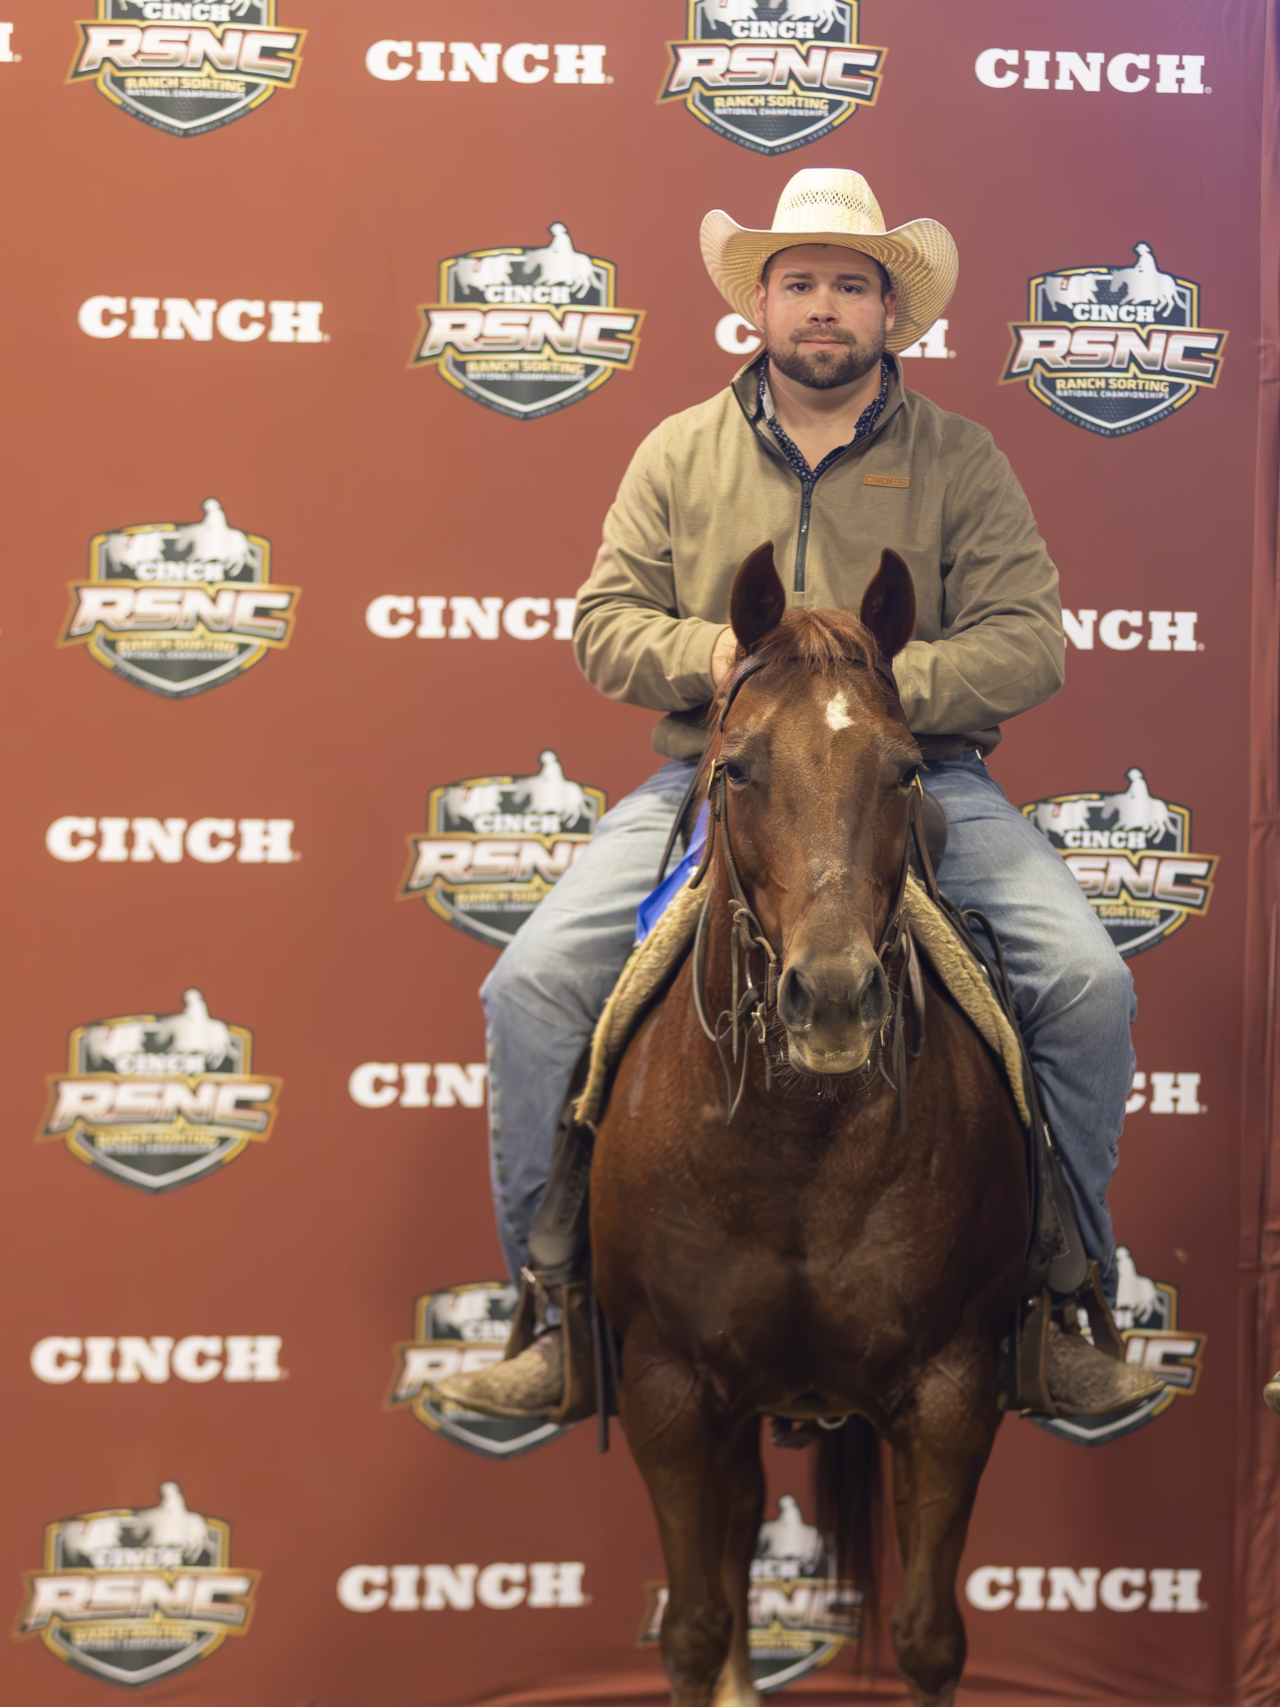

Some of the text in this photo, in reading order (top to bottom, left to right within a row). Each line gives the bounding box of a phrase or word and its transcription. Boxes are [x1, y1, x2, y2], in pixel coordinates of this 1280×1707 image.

[144, 2, 229, 21] CINCH
[732, 21, 814, 38] CINCH
[79, 25, 296, 78] RSNC
[366, 40, 606, 84] CINCH
[670, 45, 878, 95] RSNC
[975, 48, 1204, 93] CINCH
[126, 76, 245, 92] RANCH SORTING
[715, 96, 828, 110] RANCH SORTING
[715, 108, 828, 117] NATIONAL CHAMPIONSHIPS
[486, 286, 569, 303] CINCH
[1073, 304, 1154, 322] CINCH
[78, 296, 323, 342] CINCH
[421, 310, 635, 359] RSNC
[468, 360, 584, 374] RANCH SORTING
[1011, 327, 1218, 378] RSNC
[1056, 377, 1169, 392] RANCH SORTING
[1057, 390, 1169, 399] NATIONAL CHAMPIONSHIPS
[137, 563, 223, 580] CINCH
[71, 587, 290, 637] RSNC
[1062, 609, 1197, 651] NCH
[46, 817, 293, 863] CINCH
[1064, 831, 1144, 847] CINCH
[1066, 857, 1208, 904] SNC
[348, 1061, 489, 1108] CIN
[31, 1336, 281, 1383] CINCH
[337, 1563, 584, 1612] CINCH
[966, 1567, 1200, 1611] CINCH
